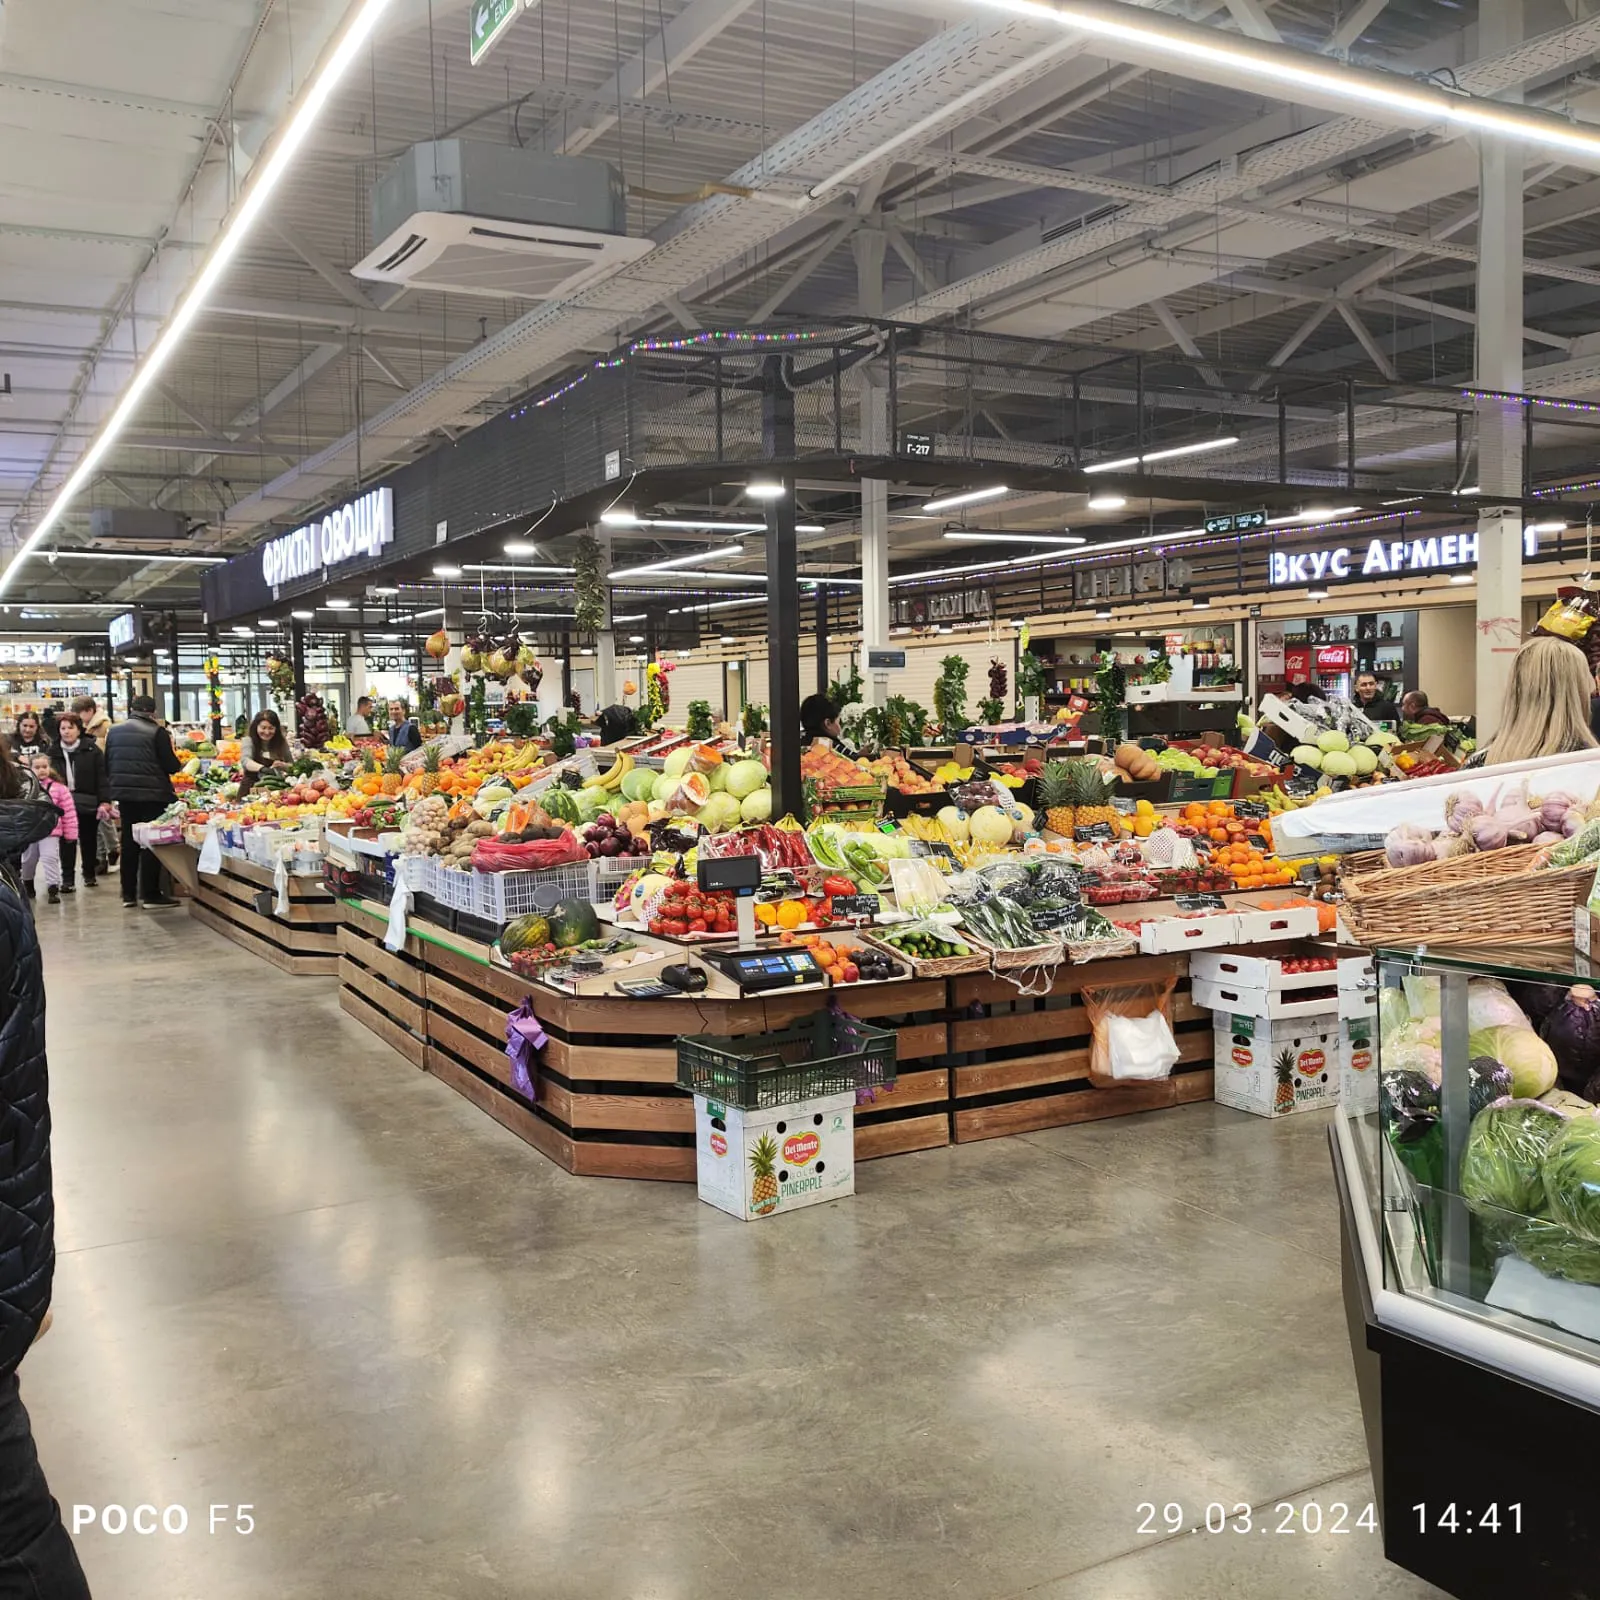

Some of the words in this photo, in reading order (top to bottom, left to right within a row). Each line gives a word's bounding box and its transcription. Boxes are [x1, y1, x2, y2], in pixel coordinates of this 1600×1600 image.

[907, 443, 930, 455] Г-217
[262, 523, 322, 587] ФРУКТЫ
[321, 487, 394, 566] ОВОЩИ
[1296, 1086, 1326, 1101] PINEAPPLE
[785, 1145, 797, 1156] Del
[796, 1140, 818, 1153] Monte
[781, 1175, 823, 1197] PINEAPPLE
